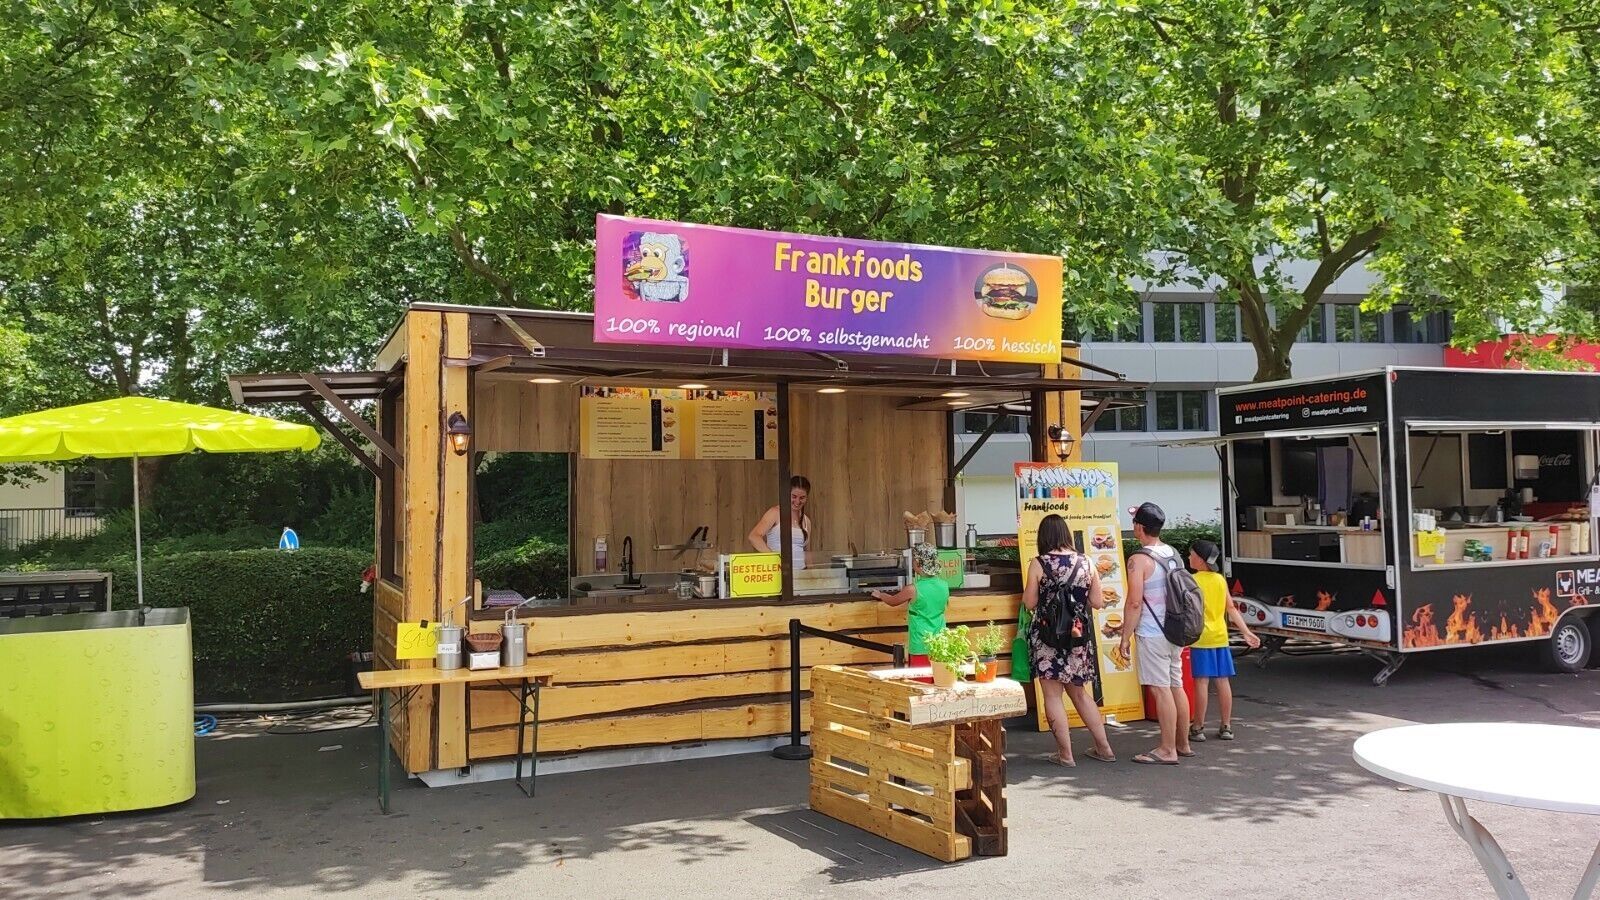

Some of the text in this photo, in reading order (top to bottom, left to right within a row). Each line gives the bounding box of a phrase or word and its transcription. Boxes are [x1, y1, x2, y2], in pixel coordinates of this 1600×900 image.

[775, 241, 924, 283] Frankfoods
[805, 278, 894, 314] Burger
[606, 317, 742, 342] 100% regional
[763, 326, 931, 351] 100% selbstgemacht
[953, 336, 1057, 354] 100% hessisch
[1235, 387, 1367, 411] www.meatpoint-catering.de
[1311, 405, 1367, 417] meatpoint_catering
[1244, 413, 1290, 423] meatpointcatering
[1019, 465, 1116, 489] FRANKFOODS
[1024, 501, 1069, 513] Frankfoods
[743, 574, 774, 583] ORDER
